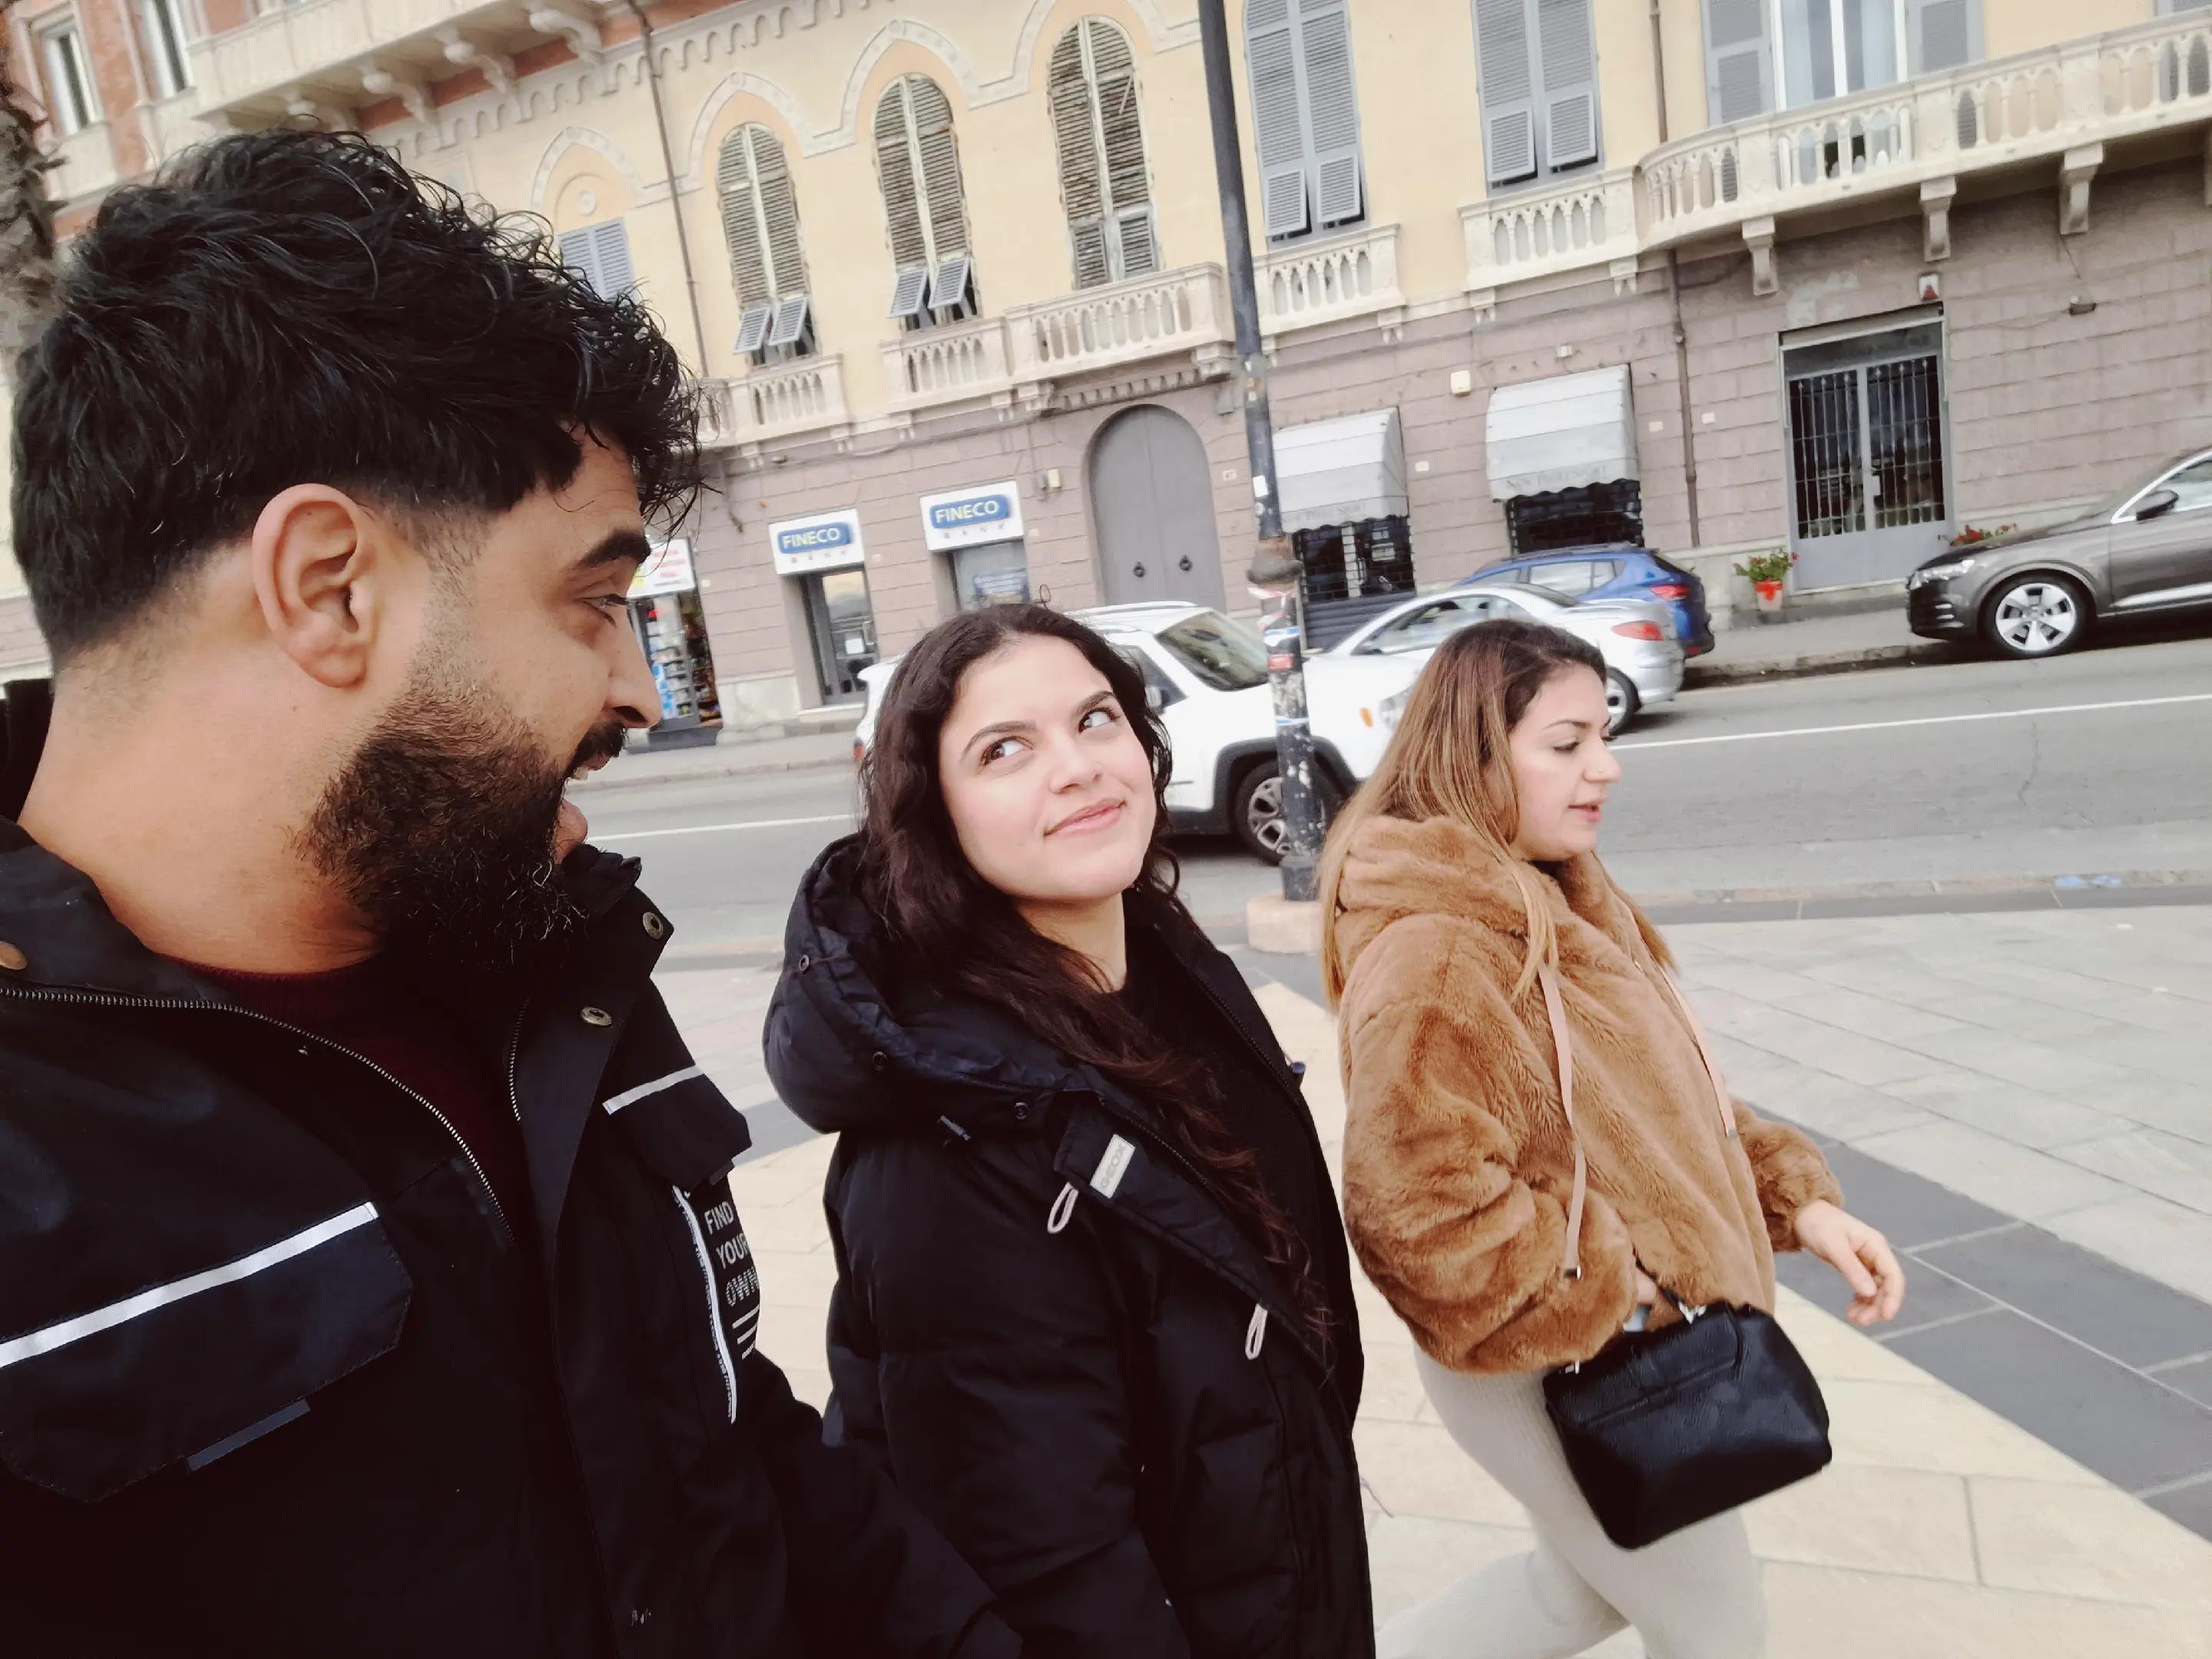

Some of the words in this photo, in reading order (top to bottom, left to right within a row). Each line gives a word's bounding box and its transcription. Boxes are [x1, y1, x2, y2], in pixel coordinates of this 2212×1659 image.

[935, 500, 998, 523] FINECO
[782, 528, 840, 549] FINECO
[1101, 1143, 1127, 1187] GEOX
[704, 1200, 734, 1235] FIND
